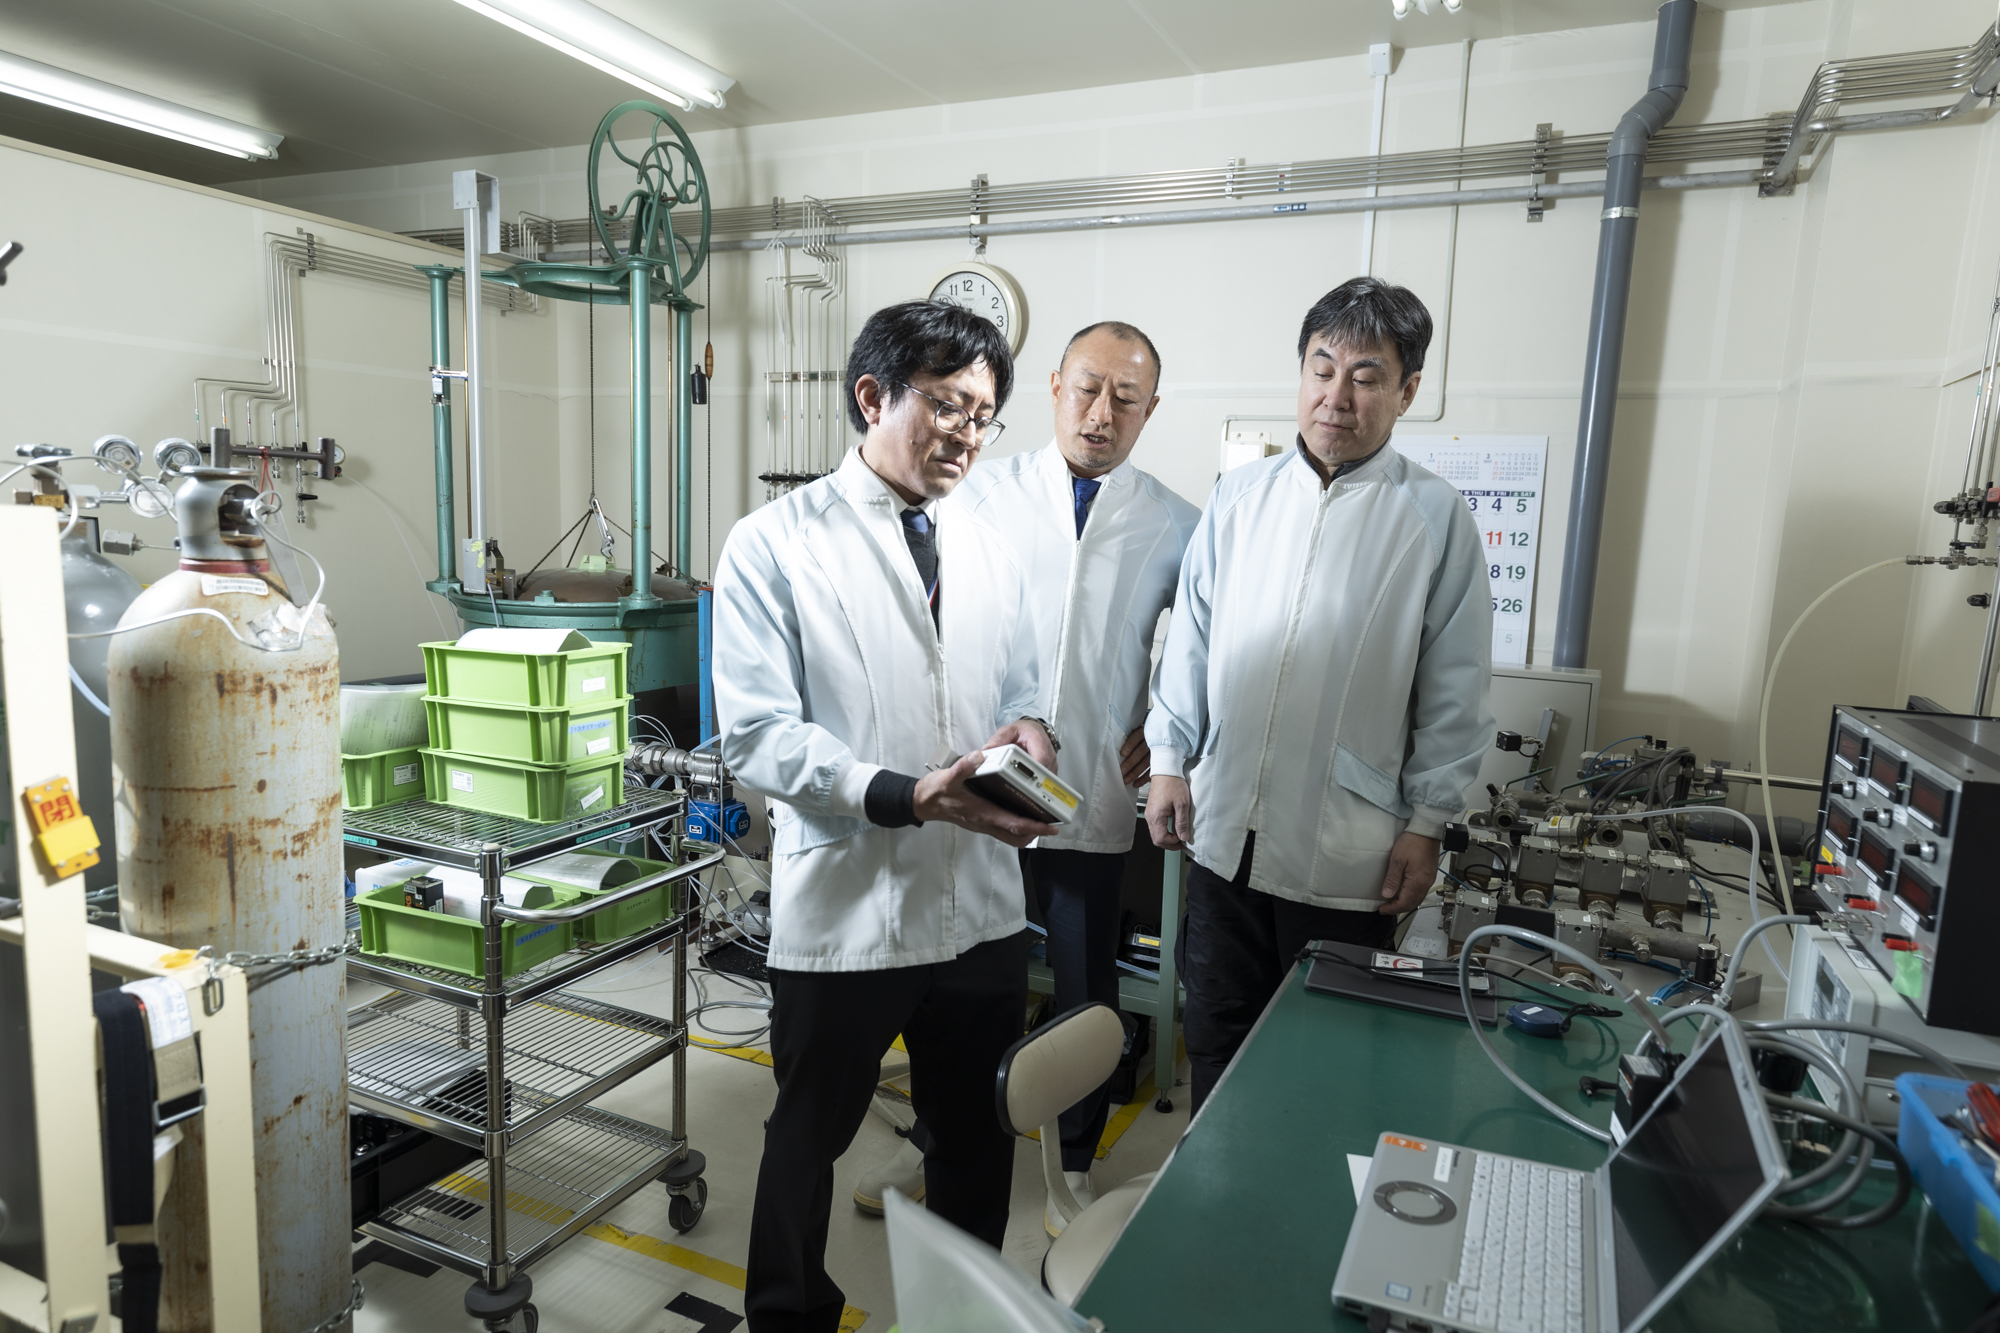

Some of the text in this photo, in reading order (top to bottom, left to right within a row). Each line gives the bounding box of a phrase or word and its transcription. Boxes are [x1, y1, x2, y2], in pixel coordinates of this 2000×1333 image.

[950, 284, 958, 296] 11
[963, 280, 973, 291] 12
[981, 284, 985, 296] 1
[991, 297, 999, 309] 2
[997, 315, 1004, 327] 3
[1468, 497, 1527, 513] 3 4 5
[1486, 531, 1529, 546] 11 12
[1487, 564, 1526, 580] 8 19
[1501, 598, 1522, 613] 26
[1505, 634, 1512, 643] 5
[40, 795, 75, 827] 閉
